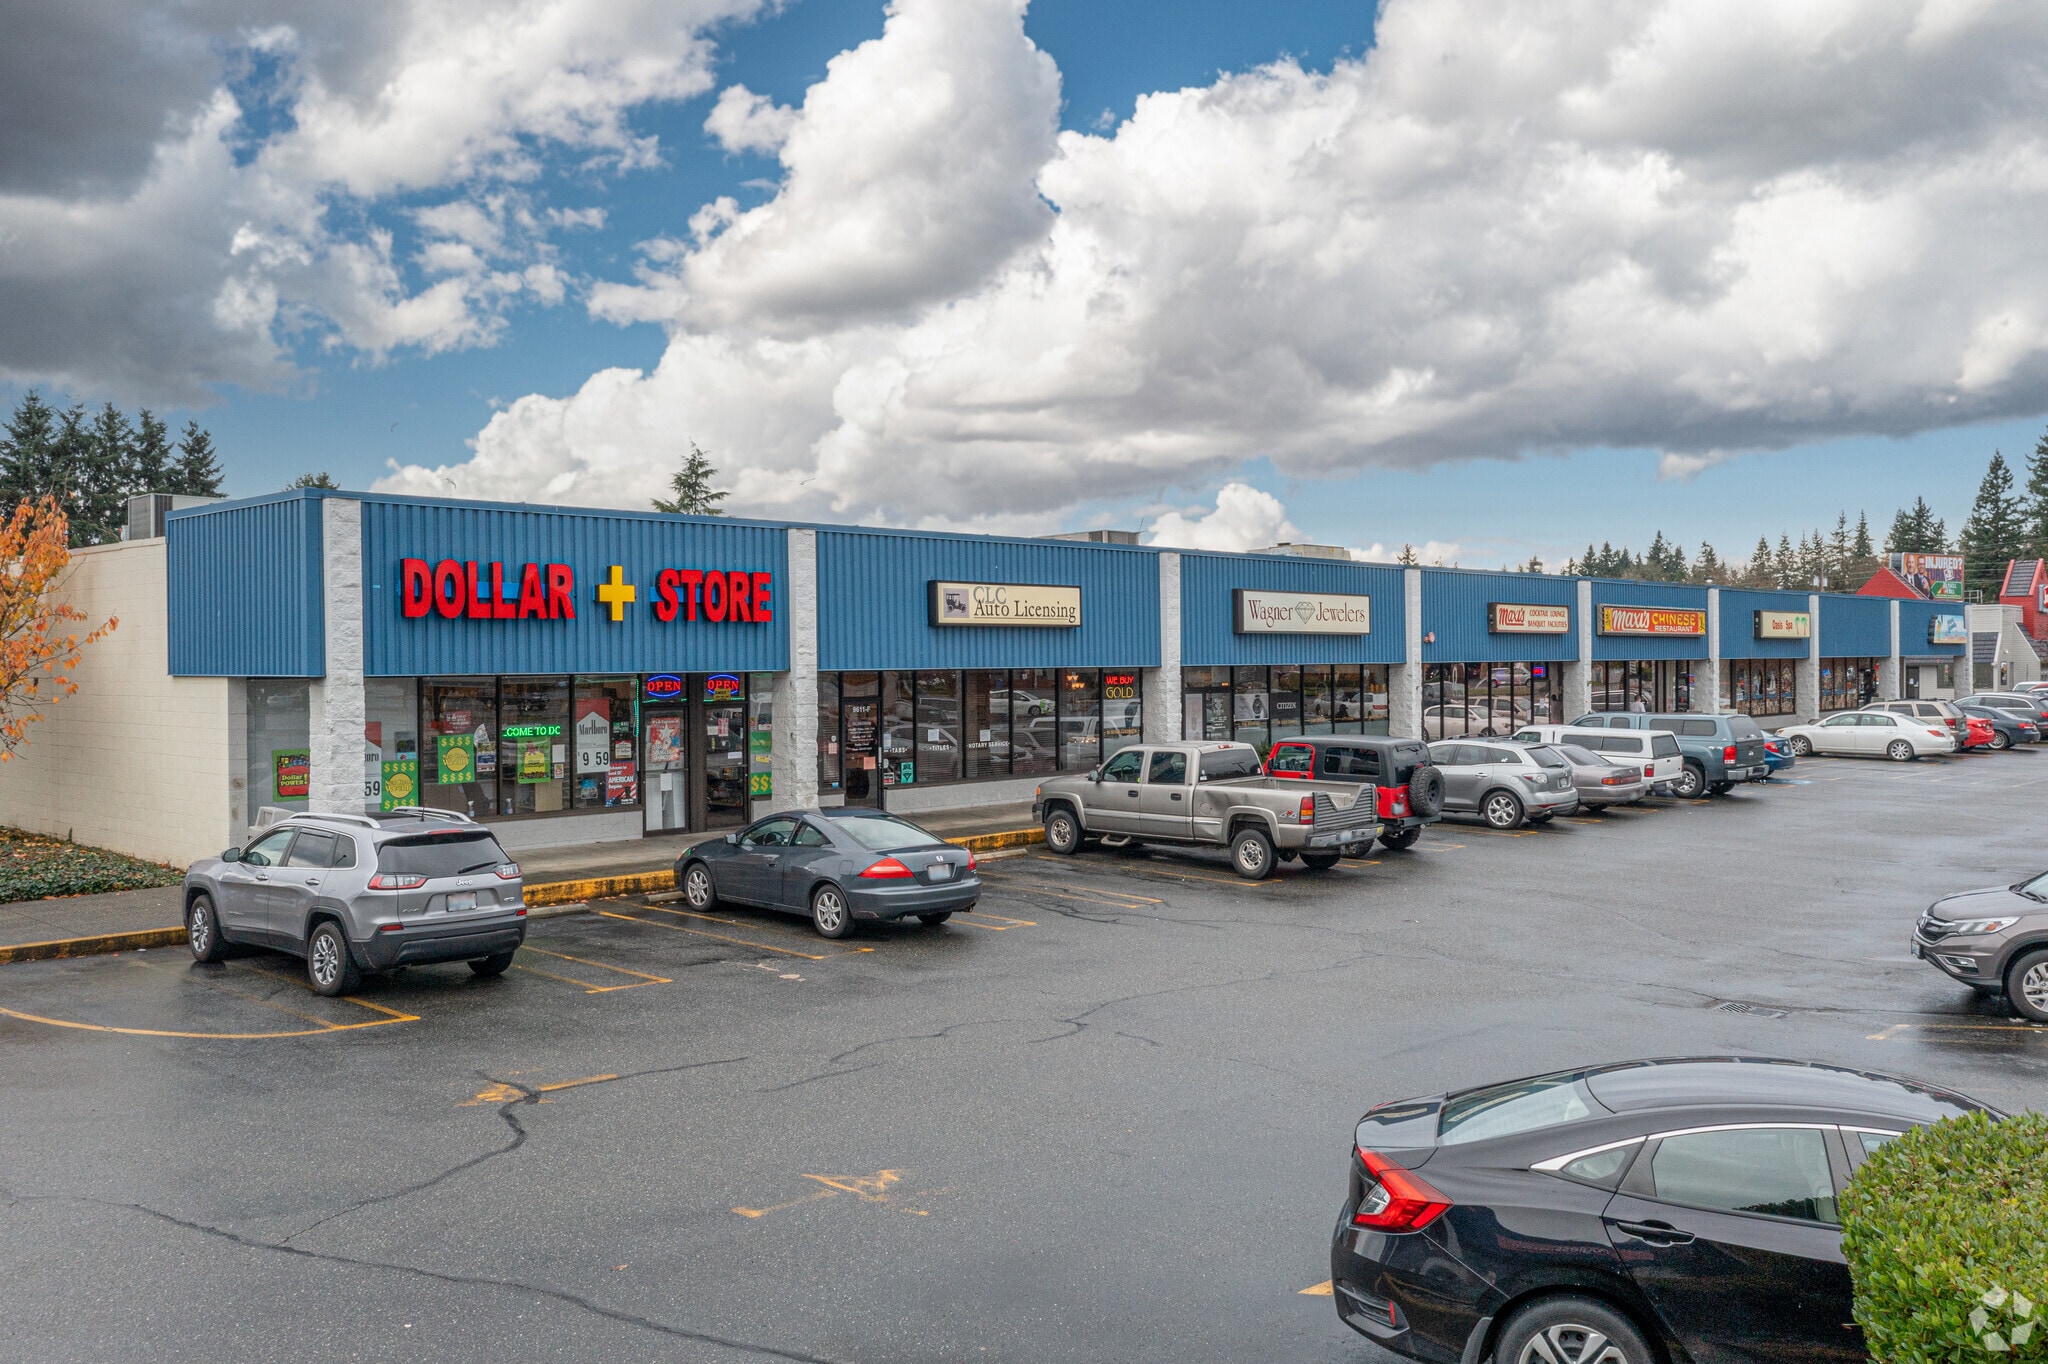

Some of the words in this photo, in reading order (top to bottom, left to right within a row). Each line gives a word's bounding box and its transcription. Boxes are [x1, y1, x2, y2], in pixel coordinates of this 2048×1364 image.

[1926, 556, 1963, 570] INJURED?
[400, 558, 576, 619] DOLLAR
[655, 568, 773, 623] STORE
[973, 586, 1007, 604] CLC
[974, 600, 1010, 617] Auto
[1014, 600, 1077, 624] Licensing
[1248, 599, 1294, 628] Wagner
[1315, 601, 1366, 623] Jewelers
[1529, 610, 1549, 618] COCKTAIL
[1550, 610, 1566, 618] LOUNGE
[1527, 619, 1546, 628] BANQUET
[1547, 620, 1567, 628] FACILITIES
[1651, 612, 1696, 627] CHINESE
[1772, 619, 1783, 630] Oasis
[1785, 619, 1793, 631] Spa
[1654, 625, 1693, 633] RESTAURANT
[707, 679, 739, 691] OPEN
[1105, 675, 1119, 685] WE
[1119, 675, 1134, 685] BUY
[647, 681, 681, 692] OPEN
[1105, 686, 1134, 699] GOLD
[1276, 702, 1297, 710] CITIZEN
[535, 726, 547, 736] TO
[579, 719, 608, 736] Marlboro
[608, 776, 634, 784] AMERICAN
